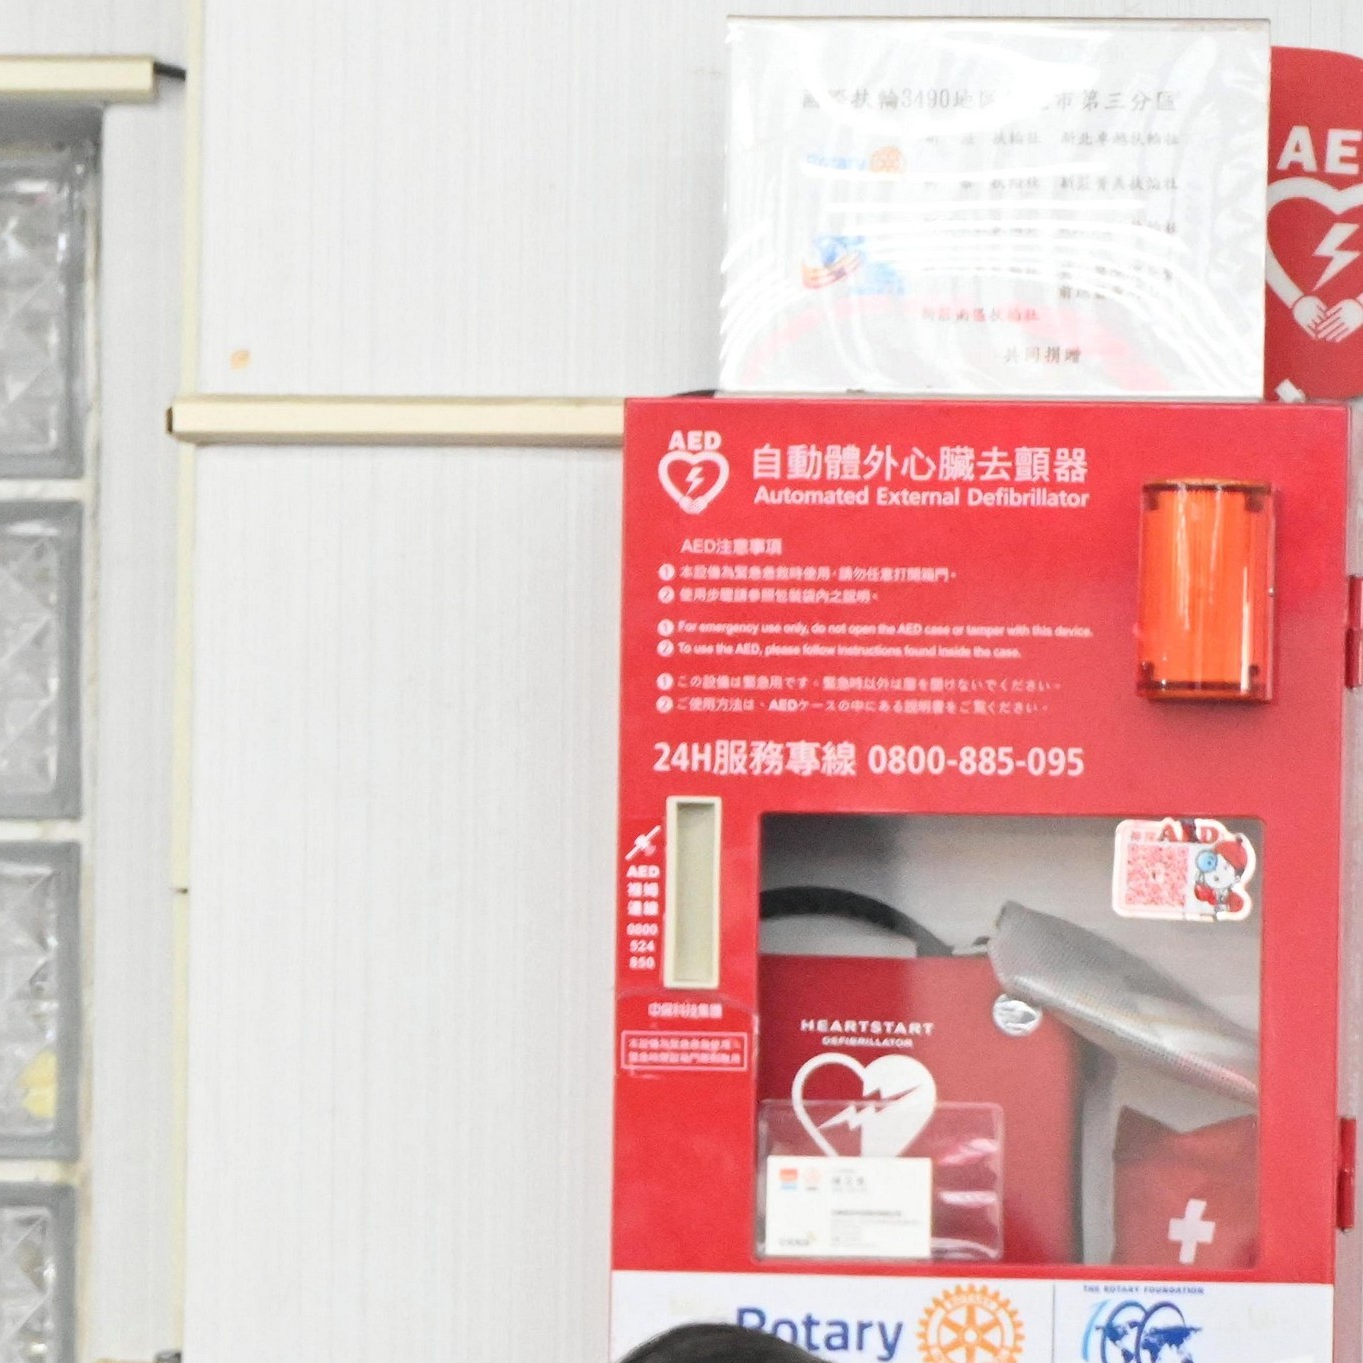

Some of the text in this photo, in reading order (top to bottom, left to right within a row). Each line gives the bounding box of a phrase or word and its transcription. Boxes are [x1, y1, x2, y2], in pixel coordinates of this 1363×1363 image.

[668, 430, 722, 450] AED
[752, 443, 1088, 483] 自動體外心臟去顫器
[753, 485, 1090, 508] Automated External Defibrillator
[680, 537, 783, 555] AED注意事項
[678, 620, 698, 633] For
[699, 622, 759, 636] emergency
[762, 623, 782, 634] use
[783, 621, 809, 636] only,
[811, 622, 826, 634] do
[828, 623, 846, 635] not
[848, 624, 876, 637] open
[878, 623, 896, 635] the
[896, 623, 922, 635] AED
[924, 625, 950, 636] case
[952, 626, 965, 636] or
[966, 624, 1005, 638] tamper
[1007, 624, 1030, 637] with
[1032, 624, 1053, 637] this
[1055, 625, 1094, 638] device.
[677, 641, 692, 654] To
[693, 643, 714, 655] use
[716, 642, 733, 655] the
[735, 642, 762, 656] AED,
[764, 643, 801, 657] please
[802, 643, 836, 656] follow
[837, 644, 902, 657] instructions
[903, 645, 937, 658] found
[938, 645, 972, 658] inside
[973, 646, 991, 658] the
[992, 647, 1022, 659] case.
[652, 739, 1085, 776] 24H服務專線 0800-885-095
[626, 865, 660, 878] AED
[629, 939, 656, 953] 524
[800, 1019, 934, 1036] HEARTSTART
[821, 1035, 914, 1049] DEFIBRILLATOR
[1083, 1284, 1205, 1295] THE ROTARY FOUNDATION
